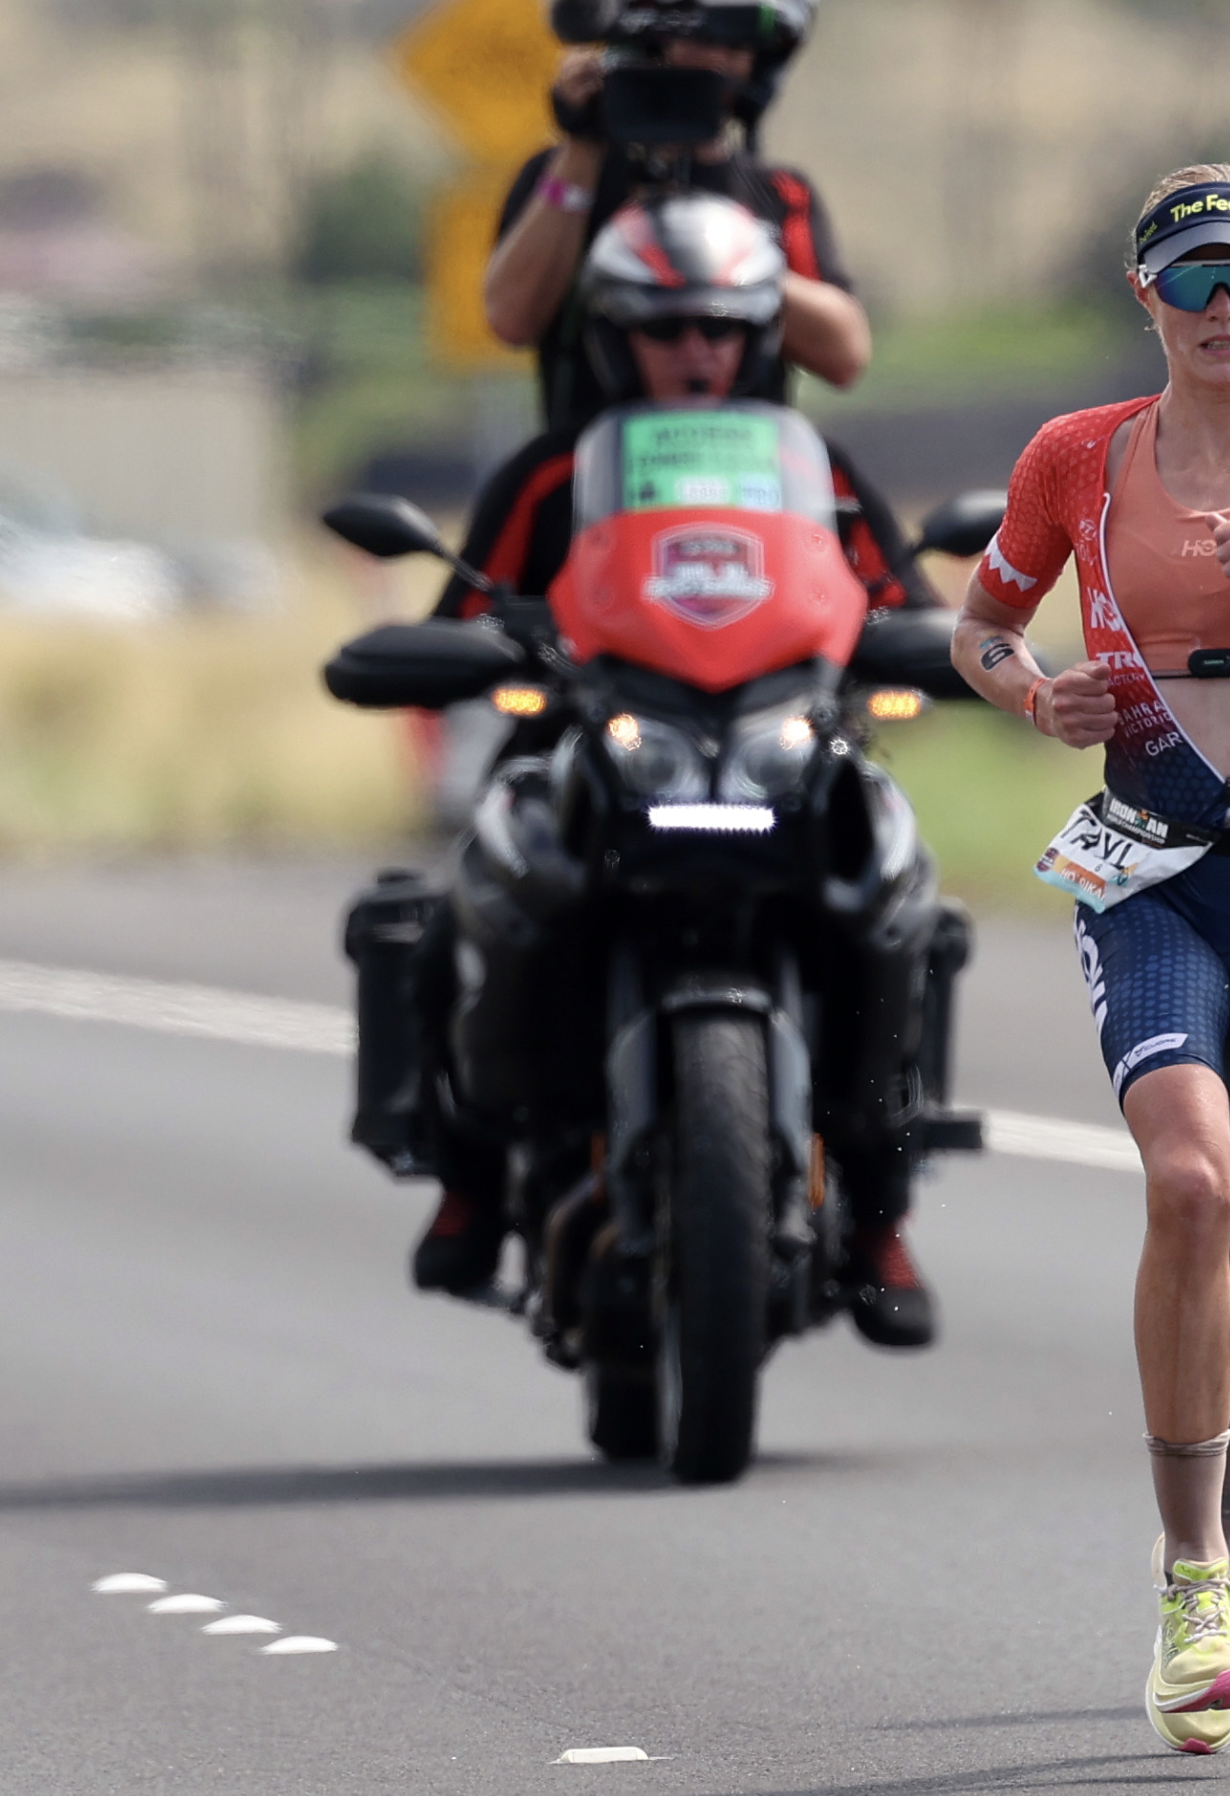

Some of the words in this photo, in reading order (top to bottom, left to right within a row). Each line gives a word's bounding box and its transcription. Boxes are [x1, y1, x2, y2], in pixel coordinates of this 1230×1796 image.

[1170, 203, 1203, 223] The
[1109, 673, 1145, 687] ACTORY
[1145, 732, 1183, 757] GAR
